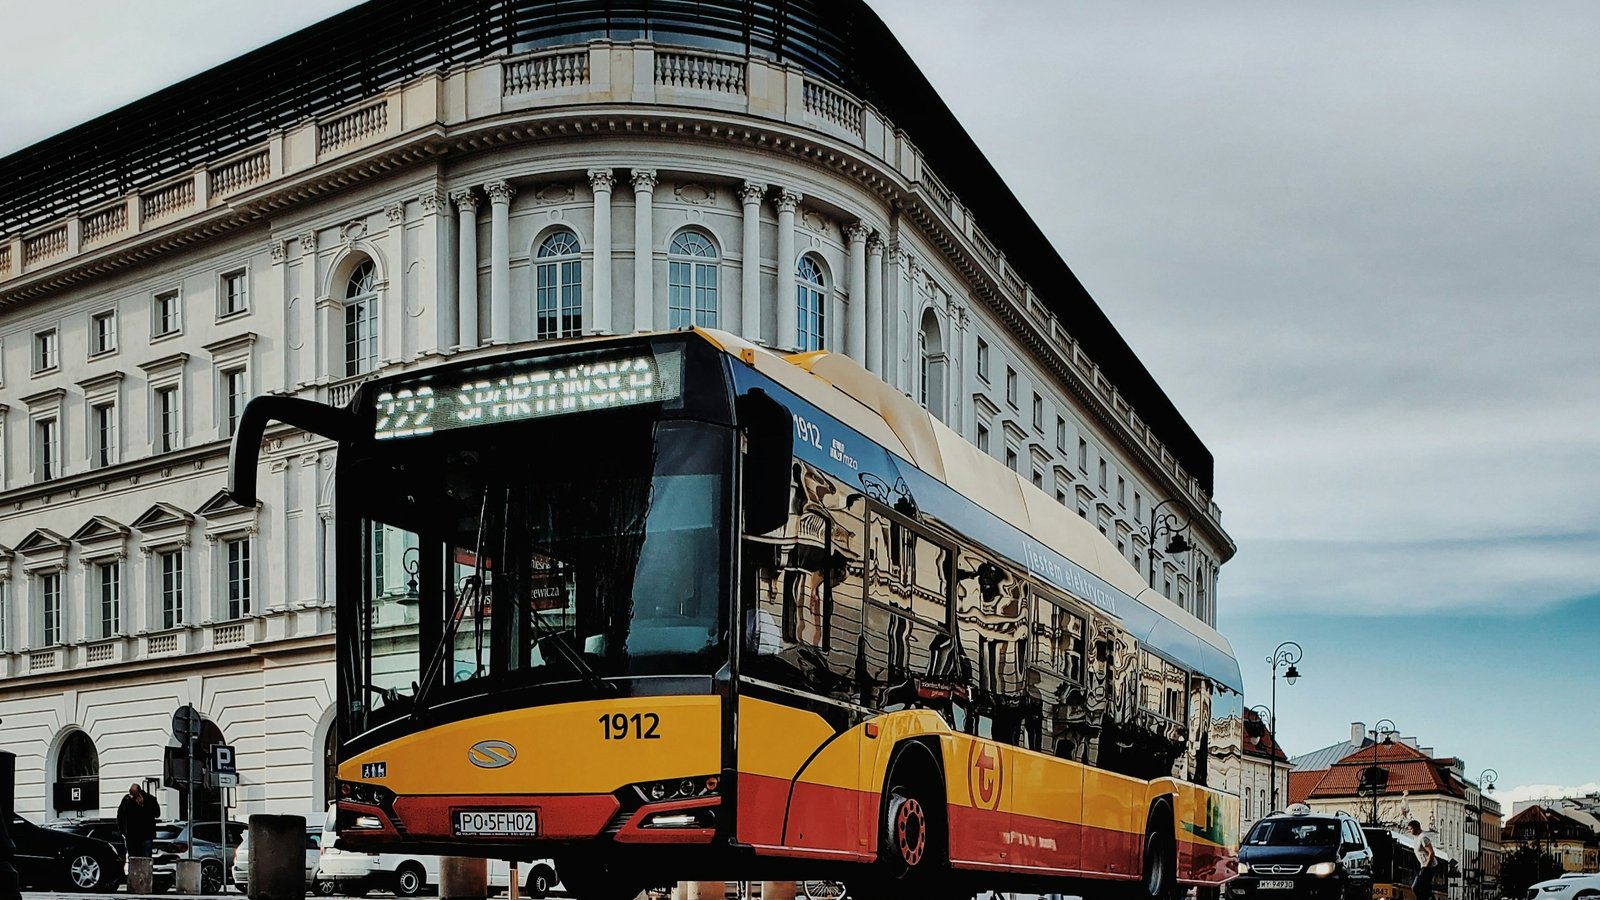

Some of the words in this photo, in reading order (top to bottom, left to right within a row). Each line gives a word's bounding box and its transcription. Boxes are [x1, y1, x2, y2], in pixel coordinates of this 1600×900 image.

[375, 386, 434, 440] 222
[793, 413, 823, 451] 1912
[1028, 543, 1063, 583] jestem
[1064, 567, 1116, 615] elektryczny
[598, 712, 661, 740] 1912
[217, 747, 231, 770] P
[462, 813, 484, 831] PO
[488, 813, 533, 831] 5FH02
